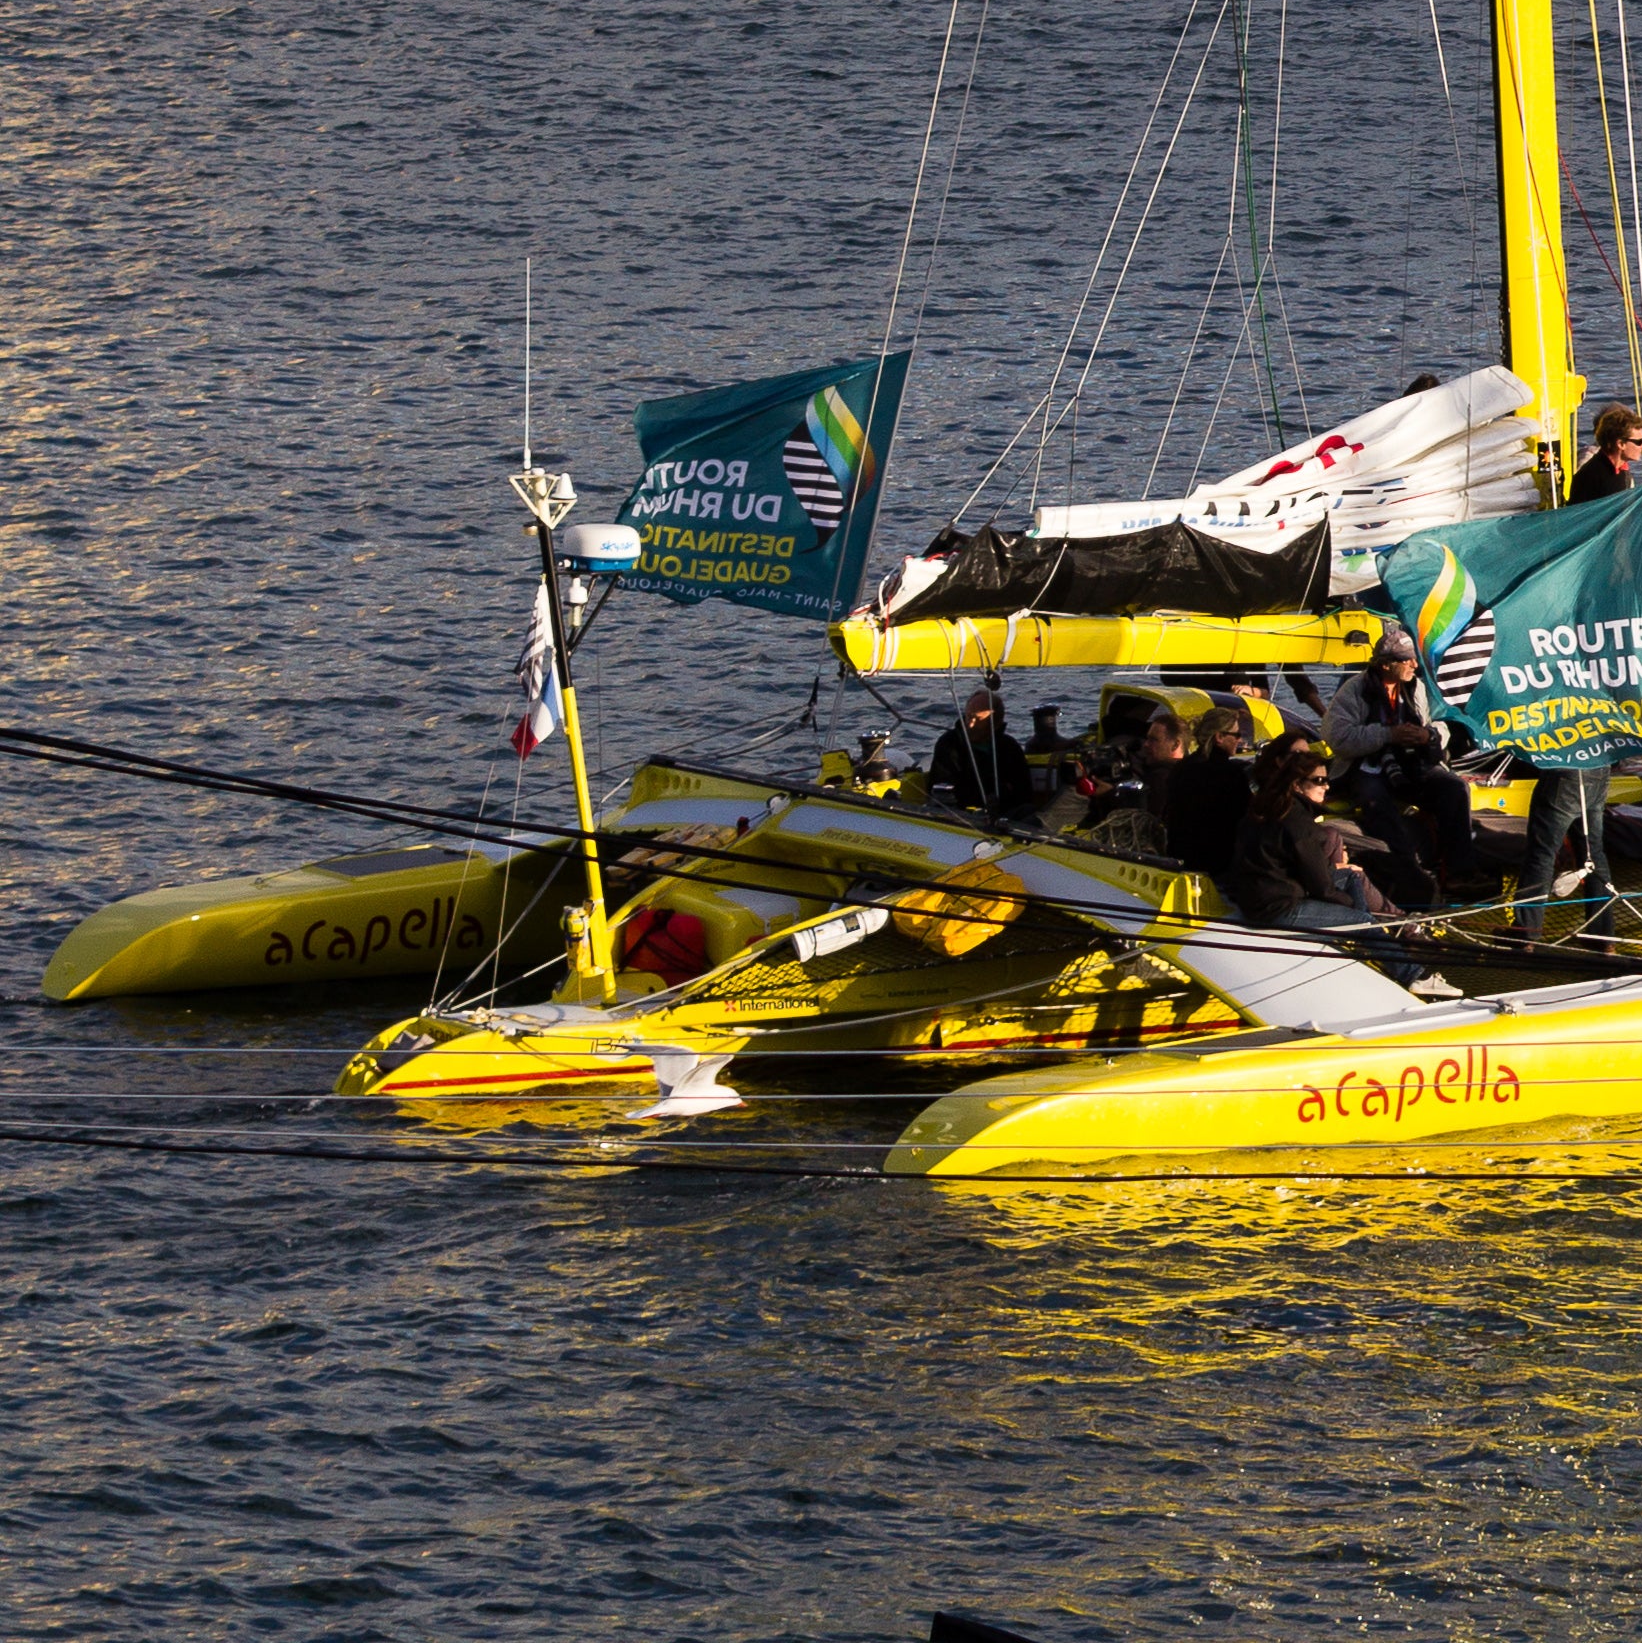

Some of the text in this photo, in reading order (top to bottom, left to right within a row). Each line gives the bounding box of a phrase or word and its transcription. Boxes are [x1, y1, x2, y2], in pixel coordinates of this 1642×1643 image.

[1500, 661, 1554, 695] DU
[264, 895, 485, 967] acapella
[738, 995, 820, 1012] International
[1297, 1045, 1520, 1124] acapella
